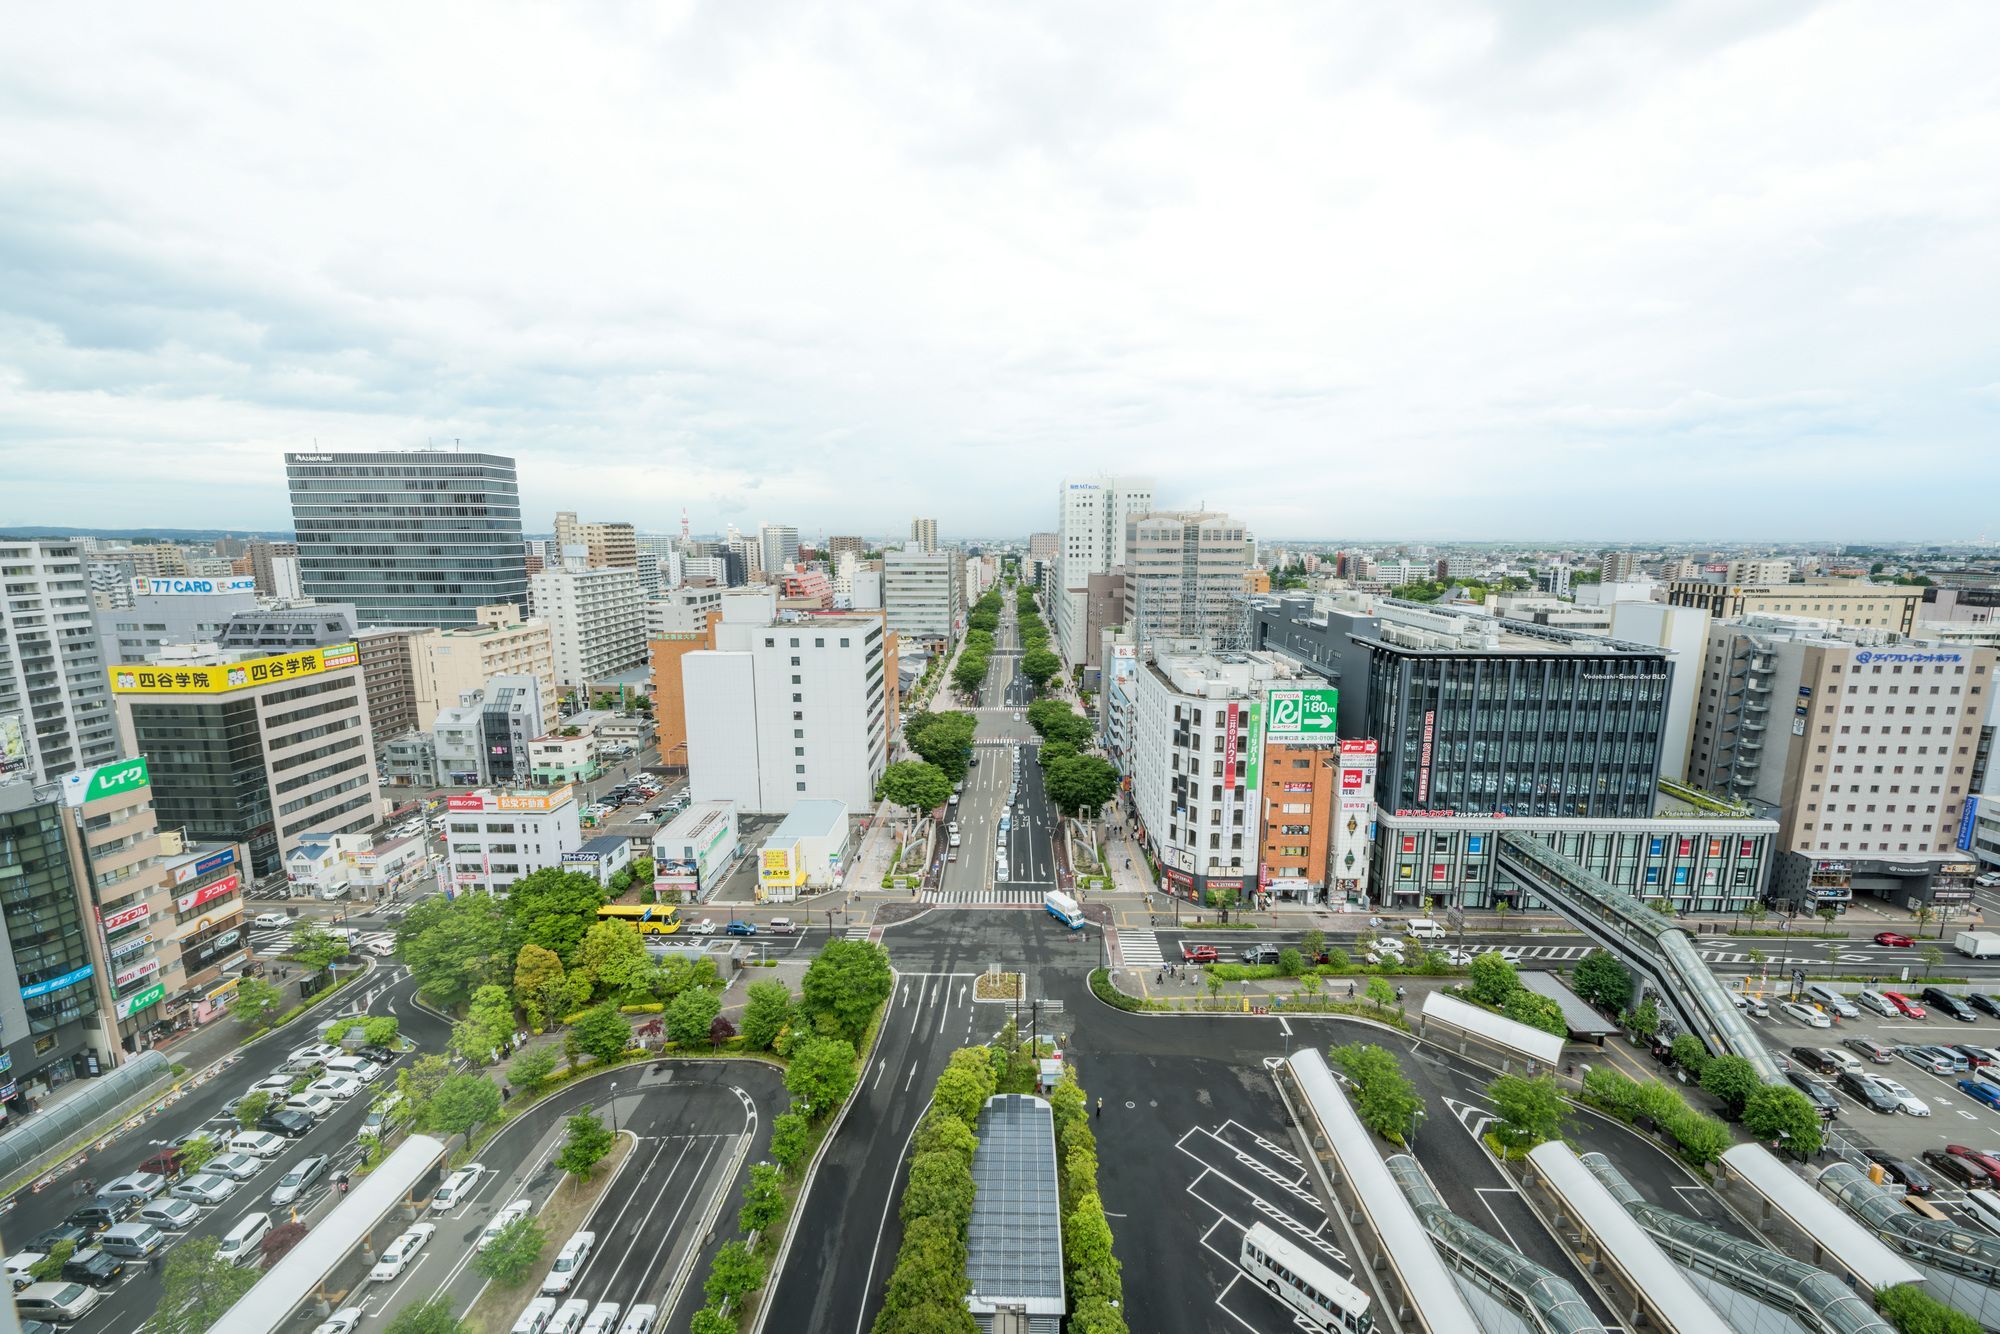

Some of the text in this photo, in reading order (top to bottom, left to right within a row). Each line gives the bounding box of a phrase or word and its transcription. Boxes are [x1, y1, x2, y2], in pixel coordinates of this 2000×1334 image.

[152, 580, 212, 593] 77 CARD
[226, 581, 255, 589] JCB
[1872, 653, 1962, 663] ダイワロイネットホテル
[251, 655, 317, 681] 四谷学院
[139, 672, 210, 688] 四谷学院
[1303, 701, 1336, 713] 180m
[1227, 714, 1237, 764] 三井のリハウス
[99, 766, 142, 789] レイク
[1395, 809, 1454, 817] ヨドバシカメラ
[204, 884, 227, 898] アコム
[116, 906, 147, 925] アイフル
[115, 940, 145, 956] LIVE MAX
[117, 961, 157, 984] mini mini
[134, 989, 160, 1007] レイク
